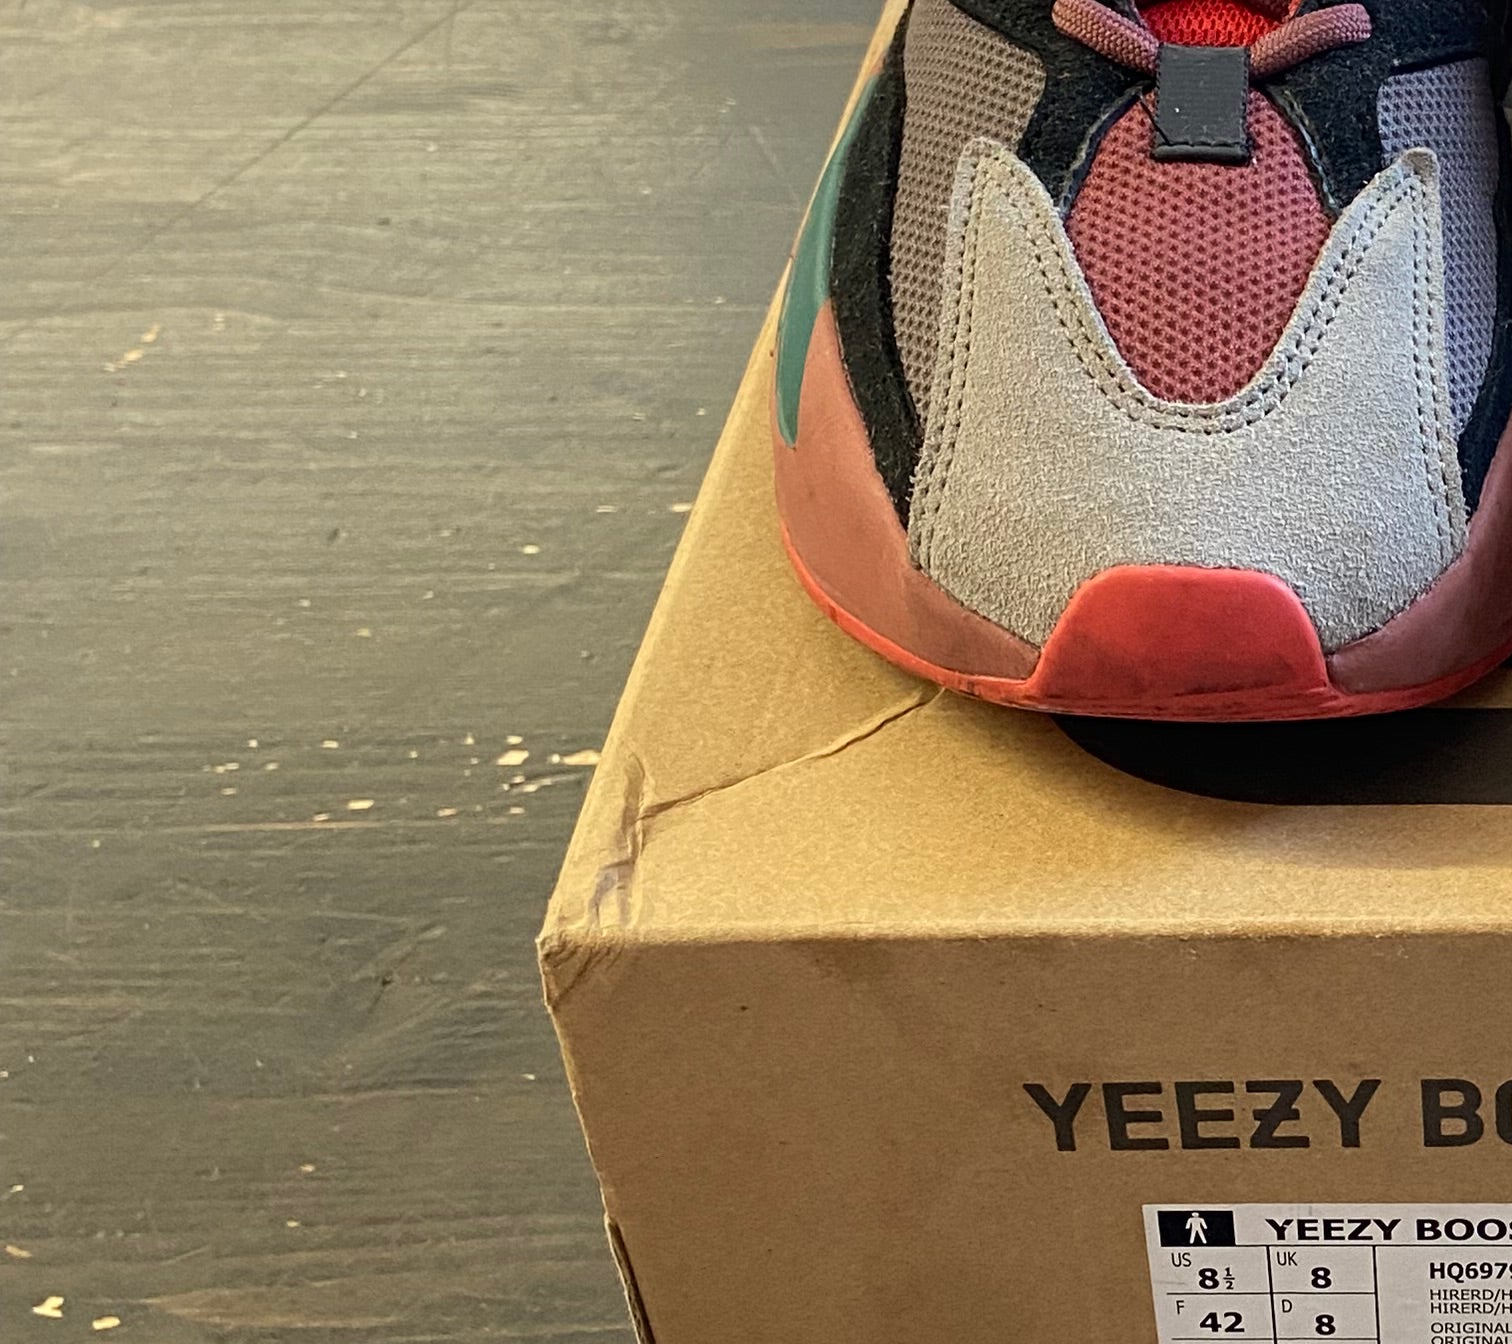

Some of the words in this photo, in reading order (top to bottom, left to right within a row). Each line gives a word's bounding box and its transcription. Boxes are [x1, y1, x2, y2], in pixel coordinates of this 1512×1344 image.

[1023, 1078, 1382, 1151] YEEZY
[1265, 1218, 1402, 1241] YEEZY
[1171, 1252, 1192, 1267] US
[1277, 1251, 1298, 1267] UK
[1311, 1267, 1332, 1289] 8
[1176, 1300, 1185, 1314] F
[1282, 1299, 1293, 1313] D
[1199, 1312, 1245, 1333] 42
[1315, 1314, 1336, 1335] 8
